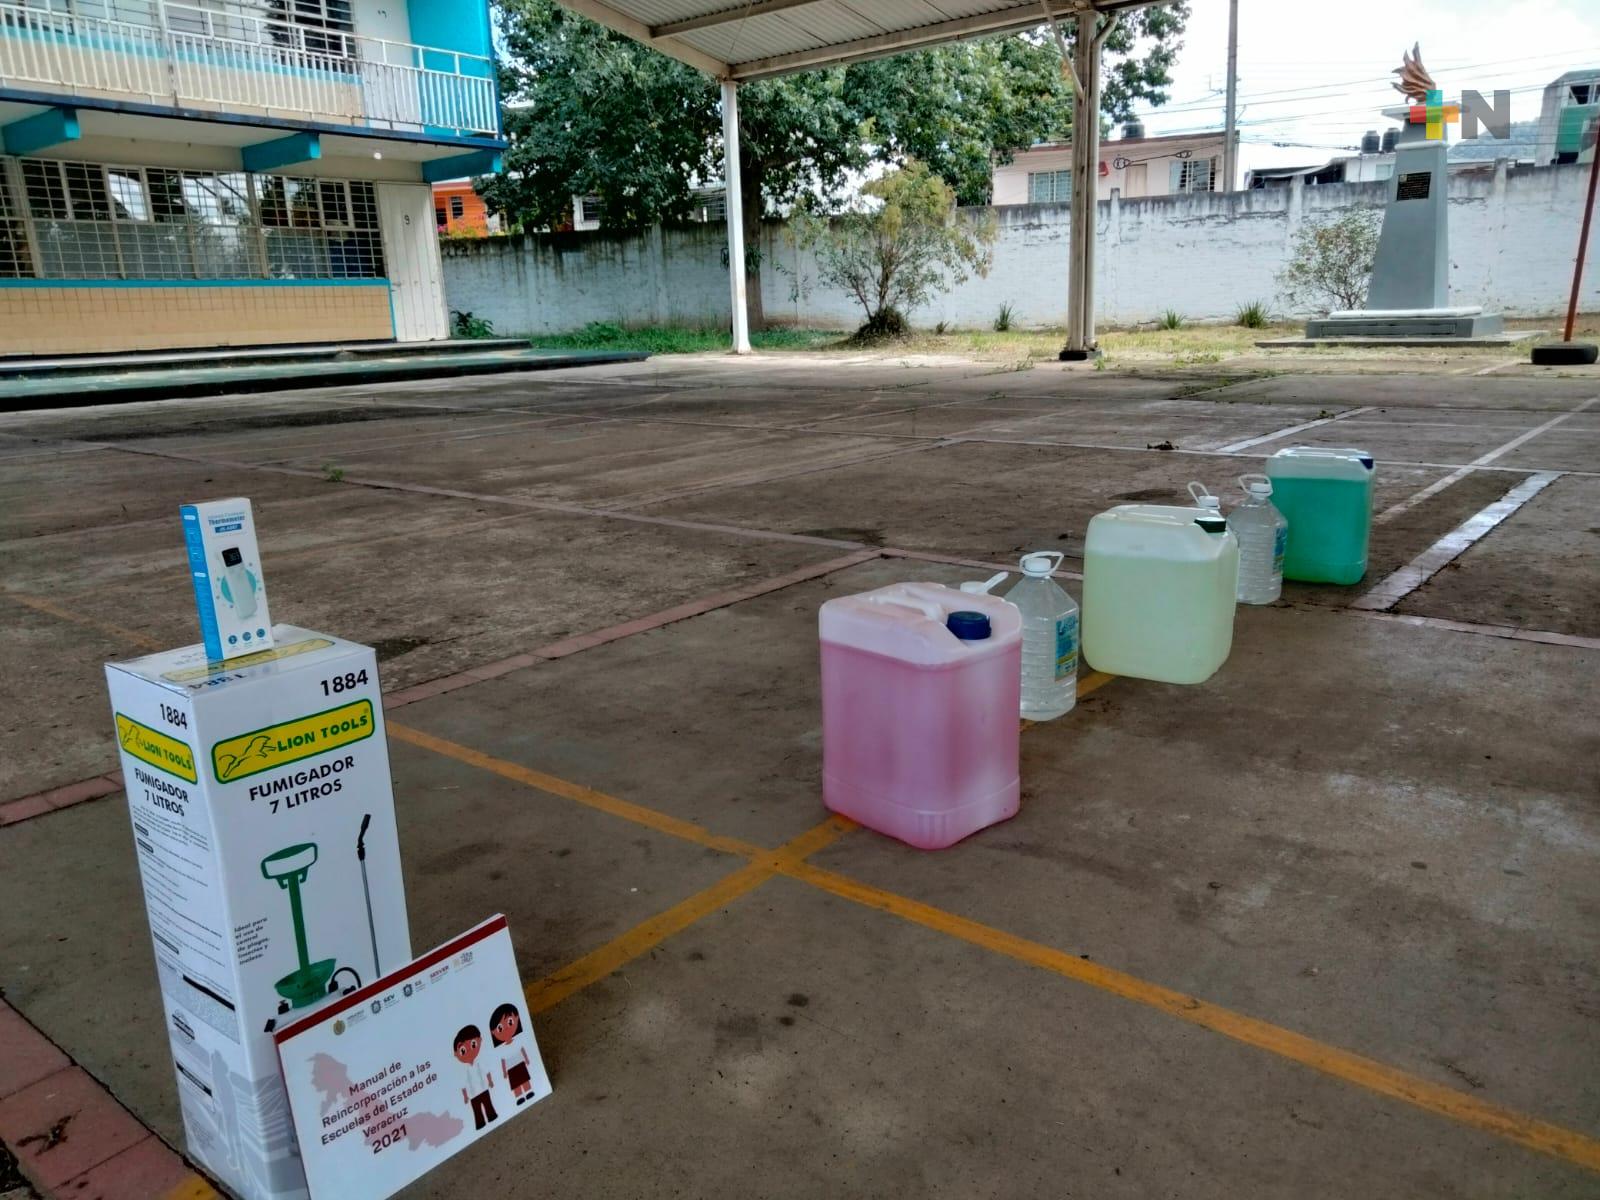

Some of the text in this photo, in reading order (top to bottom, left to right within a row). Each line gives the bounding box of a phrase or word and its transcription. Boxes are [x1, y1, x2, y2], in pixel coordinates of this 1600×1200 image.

[320, 669, 369, 697] 1884
[160, 703, 188, 730] 1884
[277, 715, 368, 752] LION TOOLS
[143, 741, 192, 770] LION TOOLS
[134, 768, 190, 803] FUMIGADOR
[249, 755, 355, 801] FUMIGADOR
[144, 789, 185, 817] 7 LITROS
[269, 778, 343, 814] 7 LITROS
[321, 1060, 431, 1129] Reincorporación a las
[348, 1061, 402, 1097] Manual de
[320, 1072, 438, 1146] Escuelas del Estado de
[362, 1106, 409, 1139] Veracruz
[371, 1123, 408, 1155] 2021
